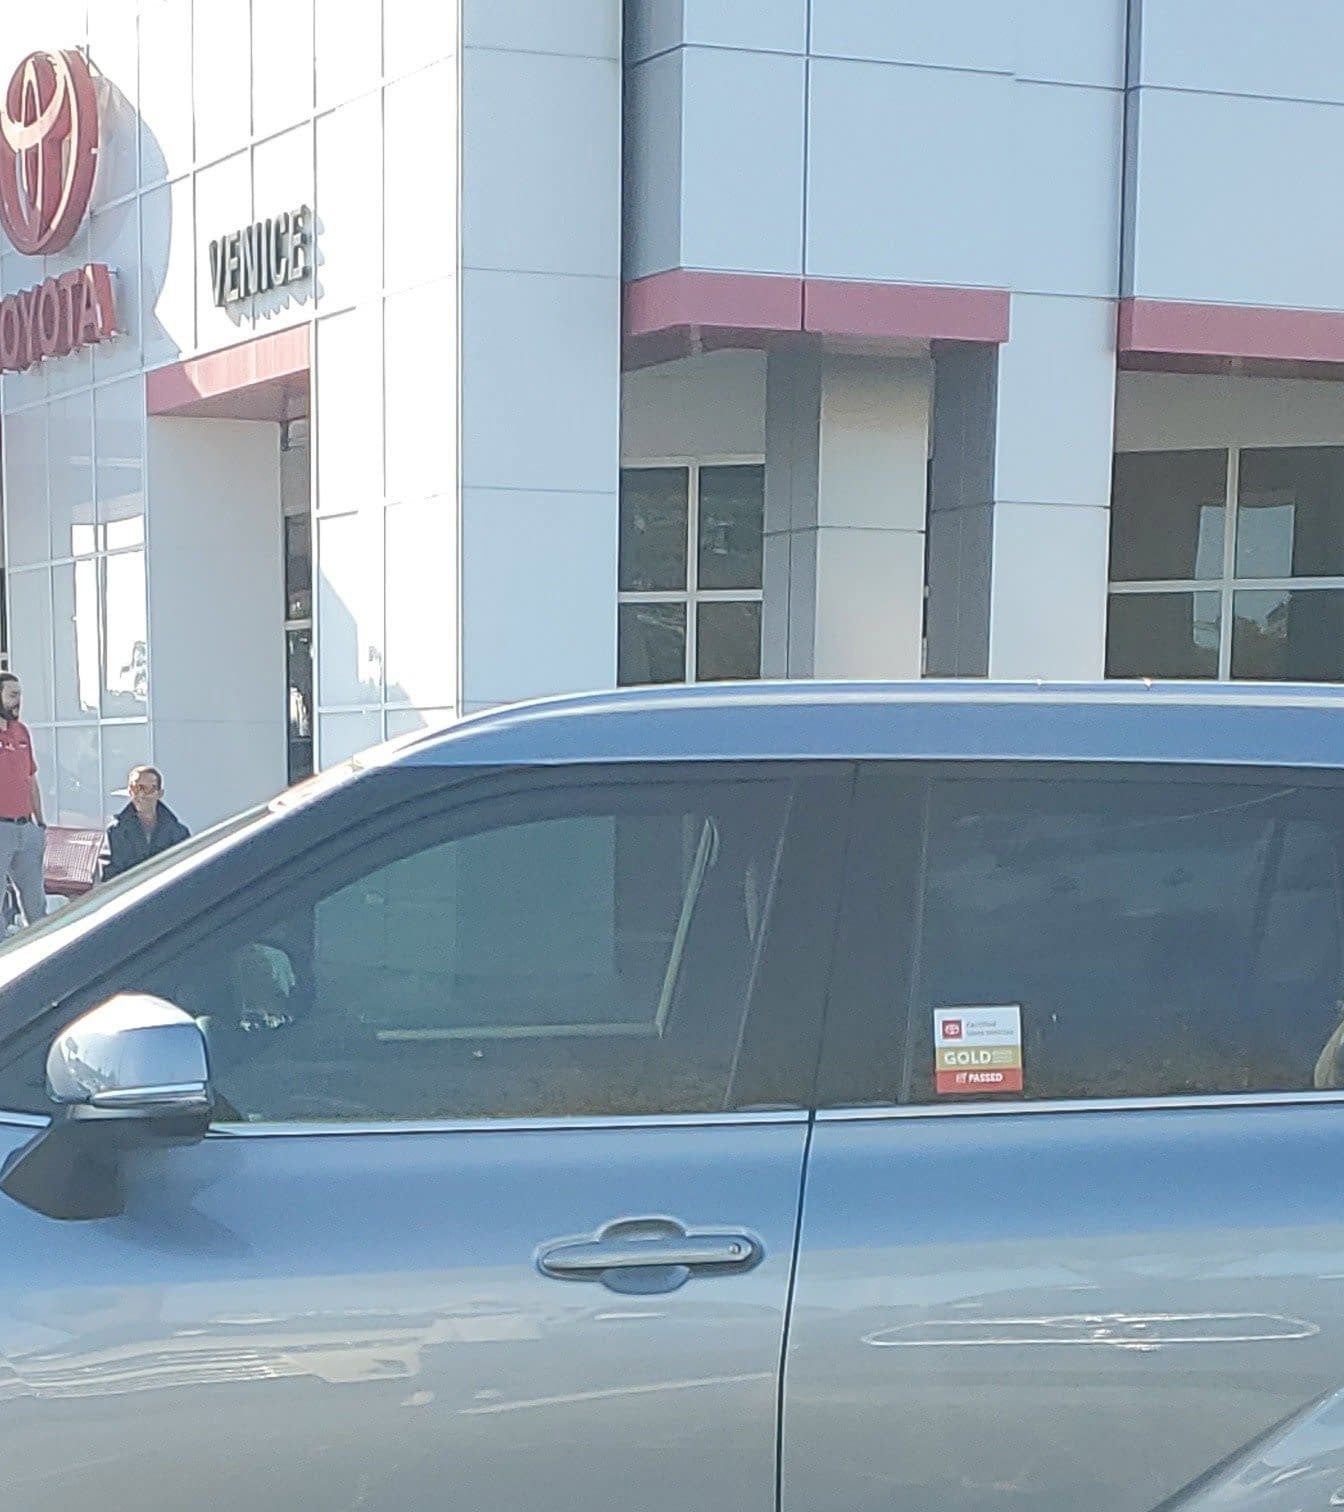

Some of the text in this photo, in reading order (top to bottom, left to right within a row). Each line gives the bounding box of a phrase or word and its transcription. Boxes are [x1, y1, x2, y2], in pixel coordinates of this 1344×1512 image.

[209, 204, 312, 307] VENICE
[944, 1050, 991, 1065] GOLD
[968, 1073, 1003, 1083] PASSED
